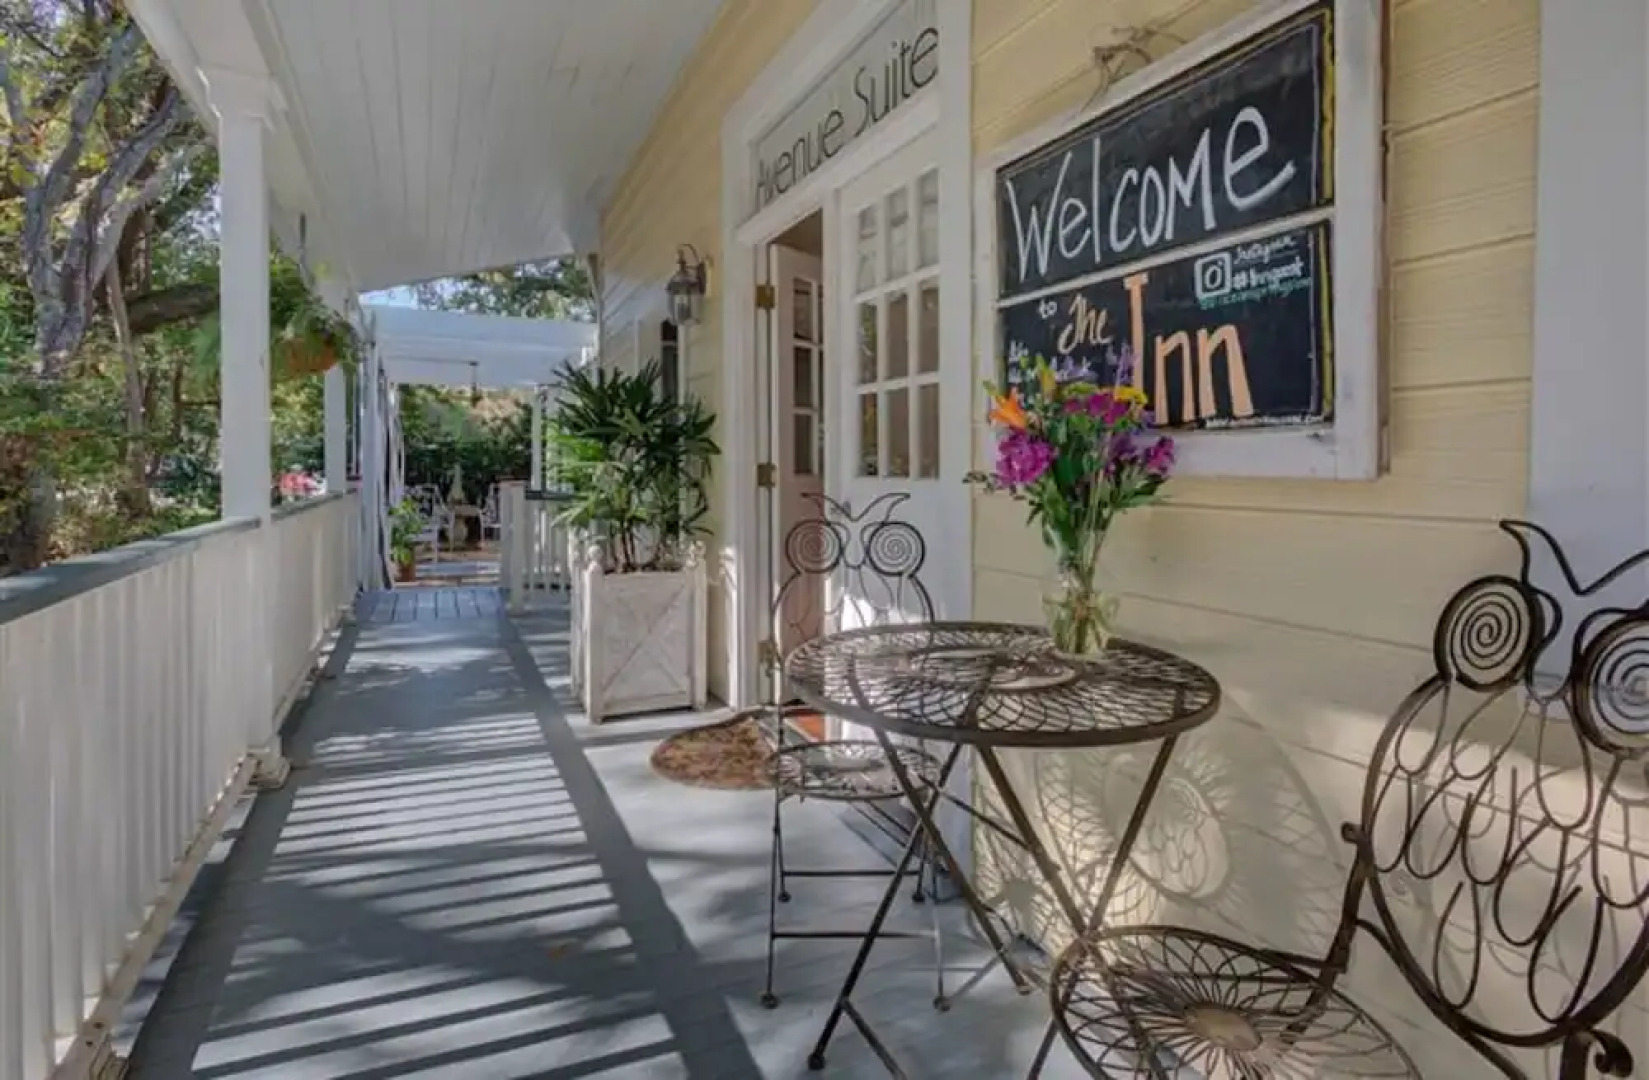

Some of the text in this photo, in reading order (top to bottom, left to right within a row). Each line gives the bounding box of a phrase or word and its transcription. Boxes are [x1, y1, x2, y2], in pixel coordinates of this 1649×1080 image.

[756, 27, 938, 211] Avenue Suite
[1039, 299, 1058, 319] to
[1124, 273, 1254, 425] Inn
